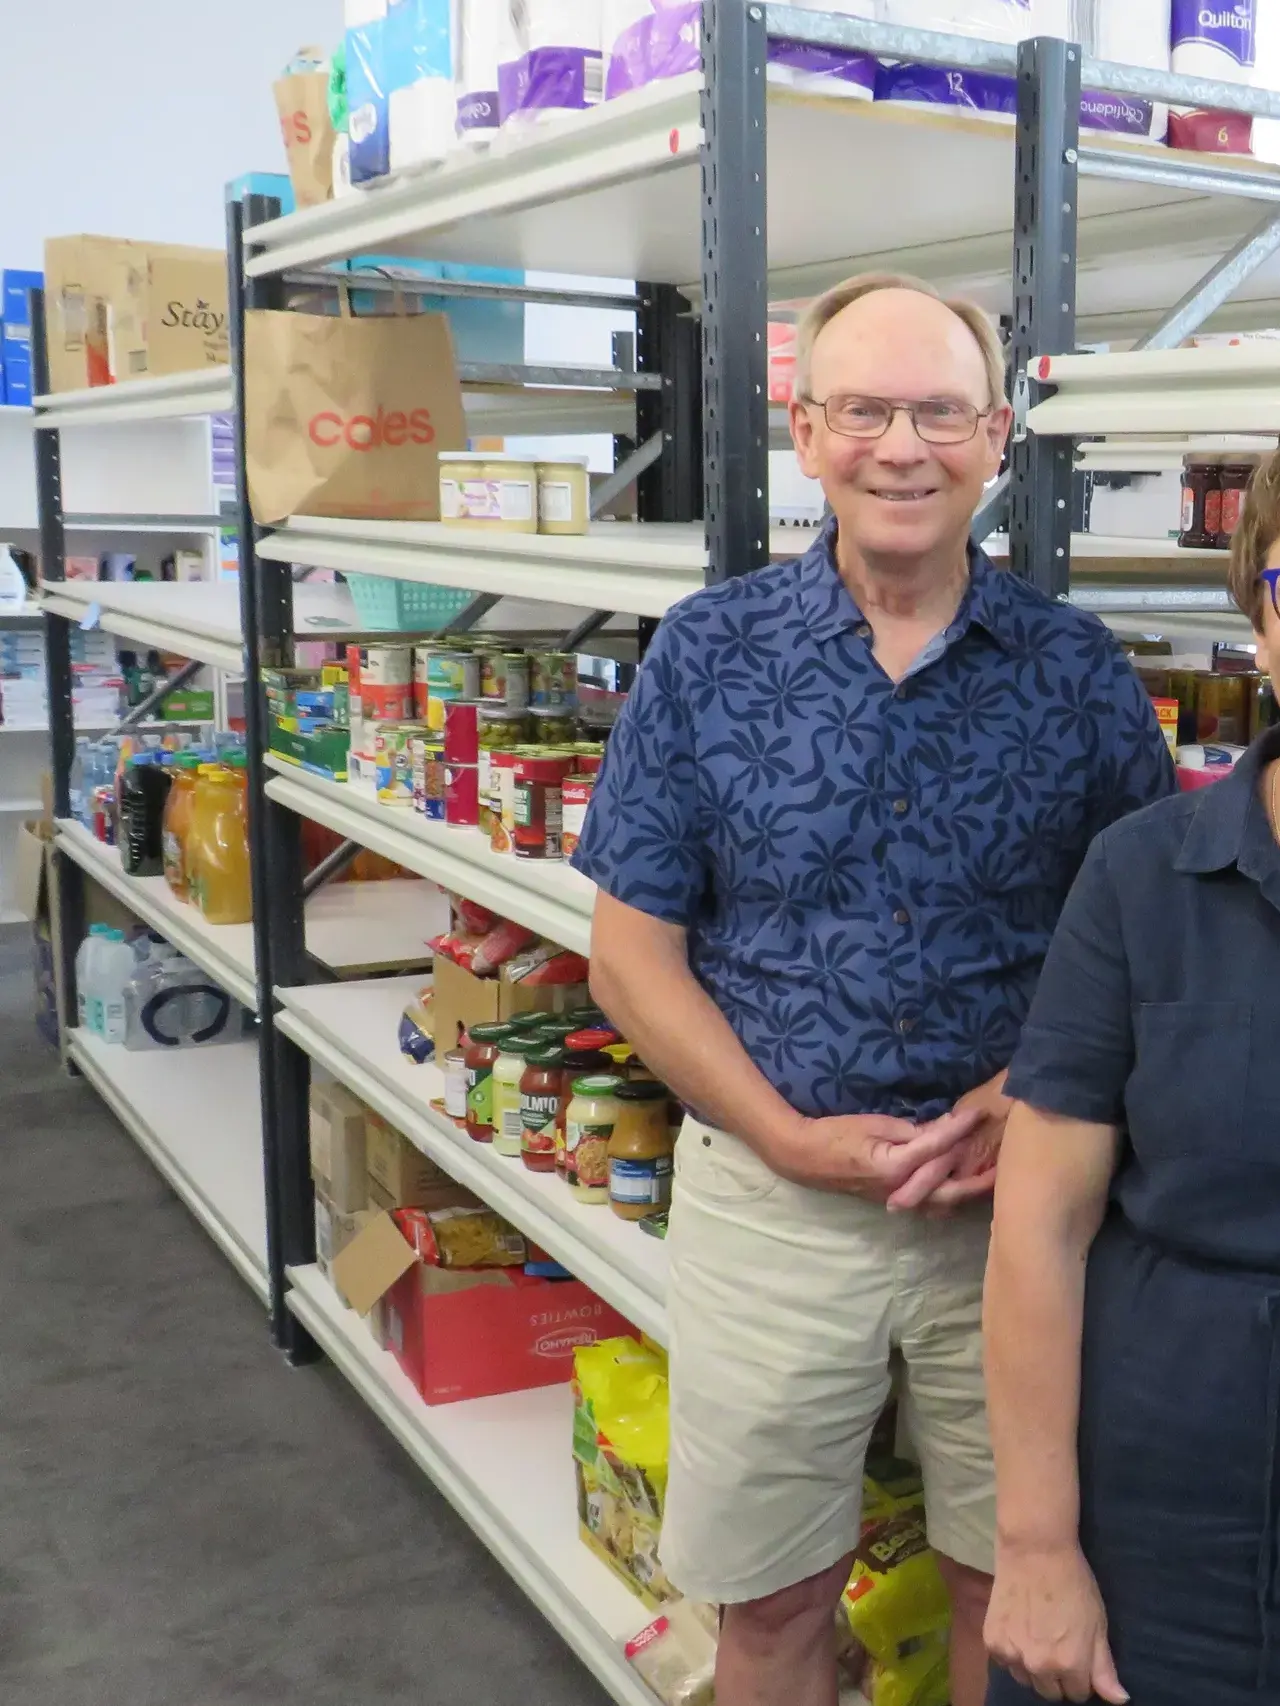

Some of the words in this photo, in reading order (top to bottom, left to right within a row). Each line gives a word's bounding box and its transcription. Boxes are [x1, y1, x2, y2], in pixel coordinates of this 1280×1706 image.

[1198, 9, 1252, 29] Quilton
[946, 72, 962, 95] 12
[1080, 99, 1144, 125] Confidenc
[1218, 126, 1228, 143] 6
[161, 300, 224, 335] Stay
[308, 404, 435, 452] coles
[530, 1304, 602, 1327] BOWTIES
